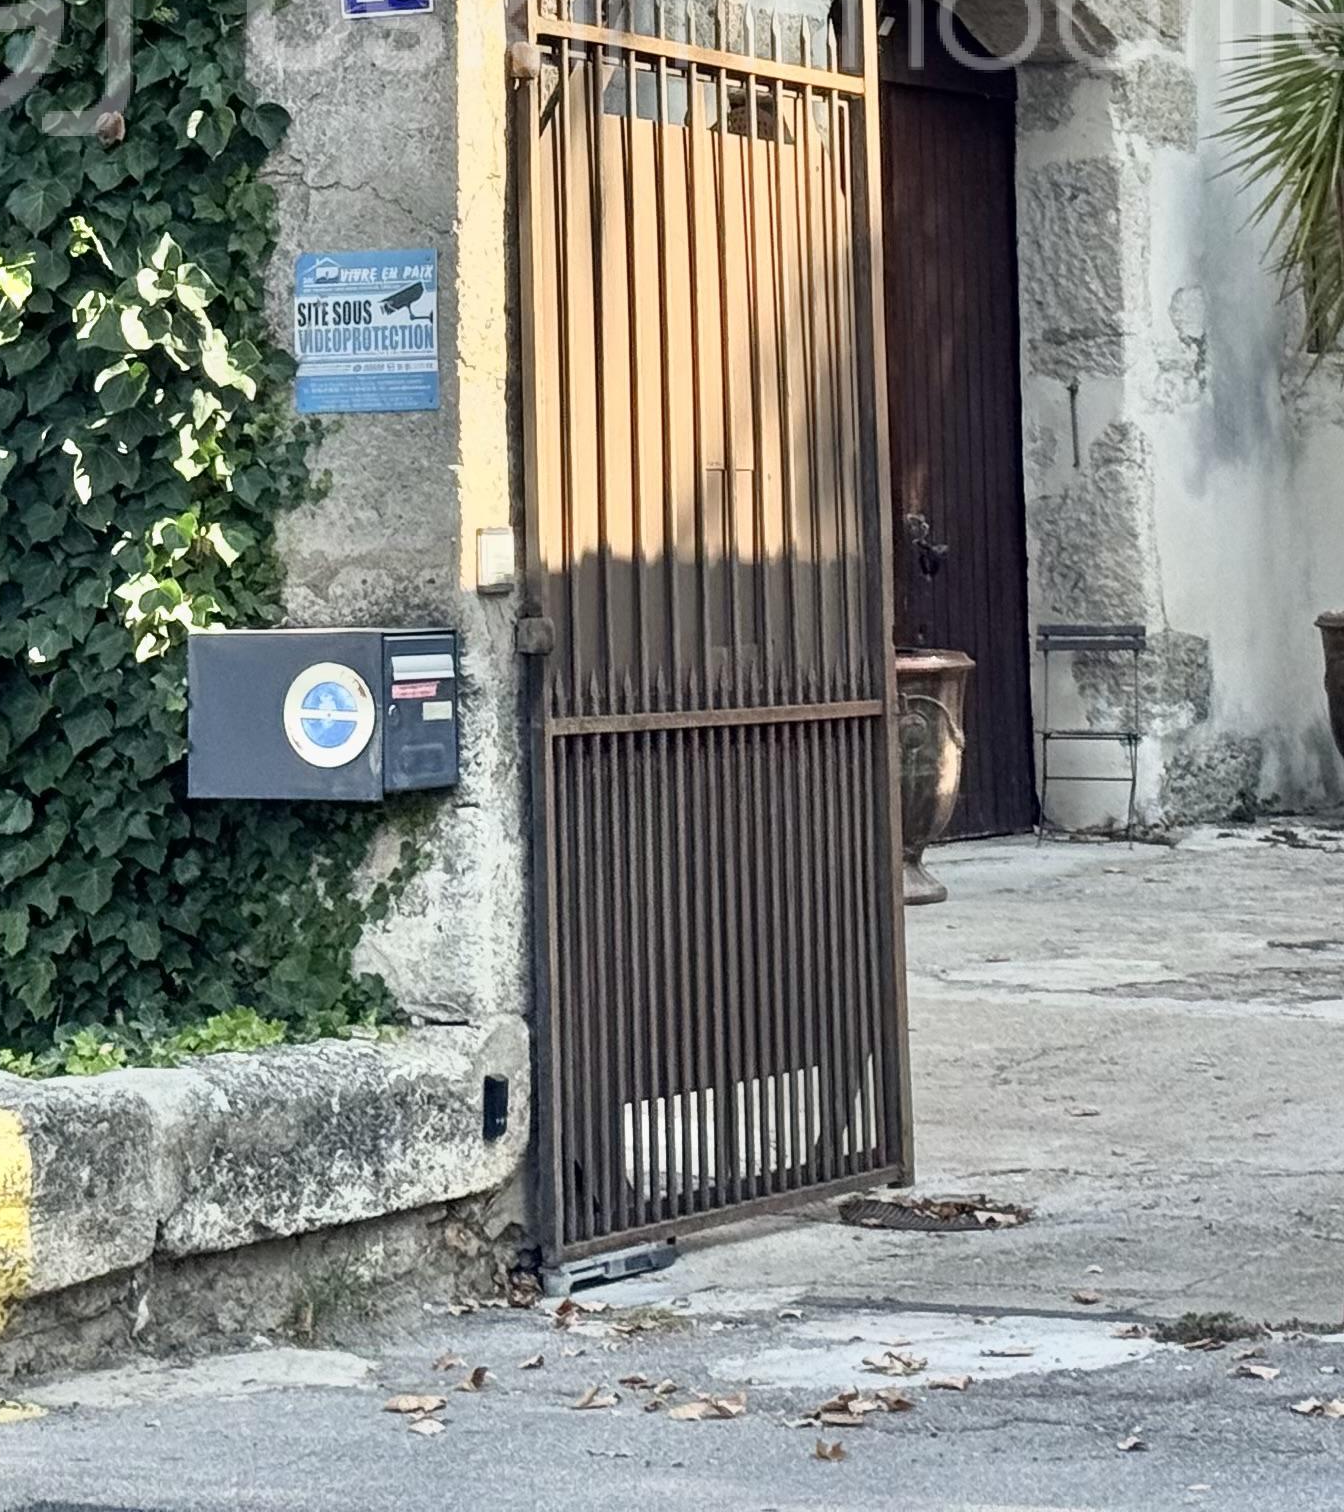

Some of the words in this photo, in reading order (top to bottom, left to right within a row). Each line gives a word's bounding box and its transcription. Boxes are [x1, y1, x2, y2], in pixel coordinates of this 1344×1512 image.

[339, 267, 377, 283] VIVRE
[381, 266, 398, 279] EN
[402, 264, 434, 279] PAIX
[297, 301, 329, 327] SITE
[332, 299, 373, 326] SOUS
[298, 324, 434, 354] VIDEOPROTECTION
